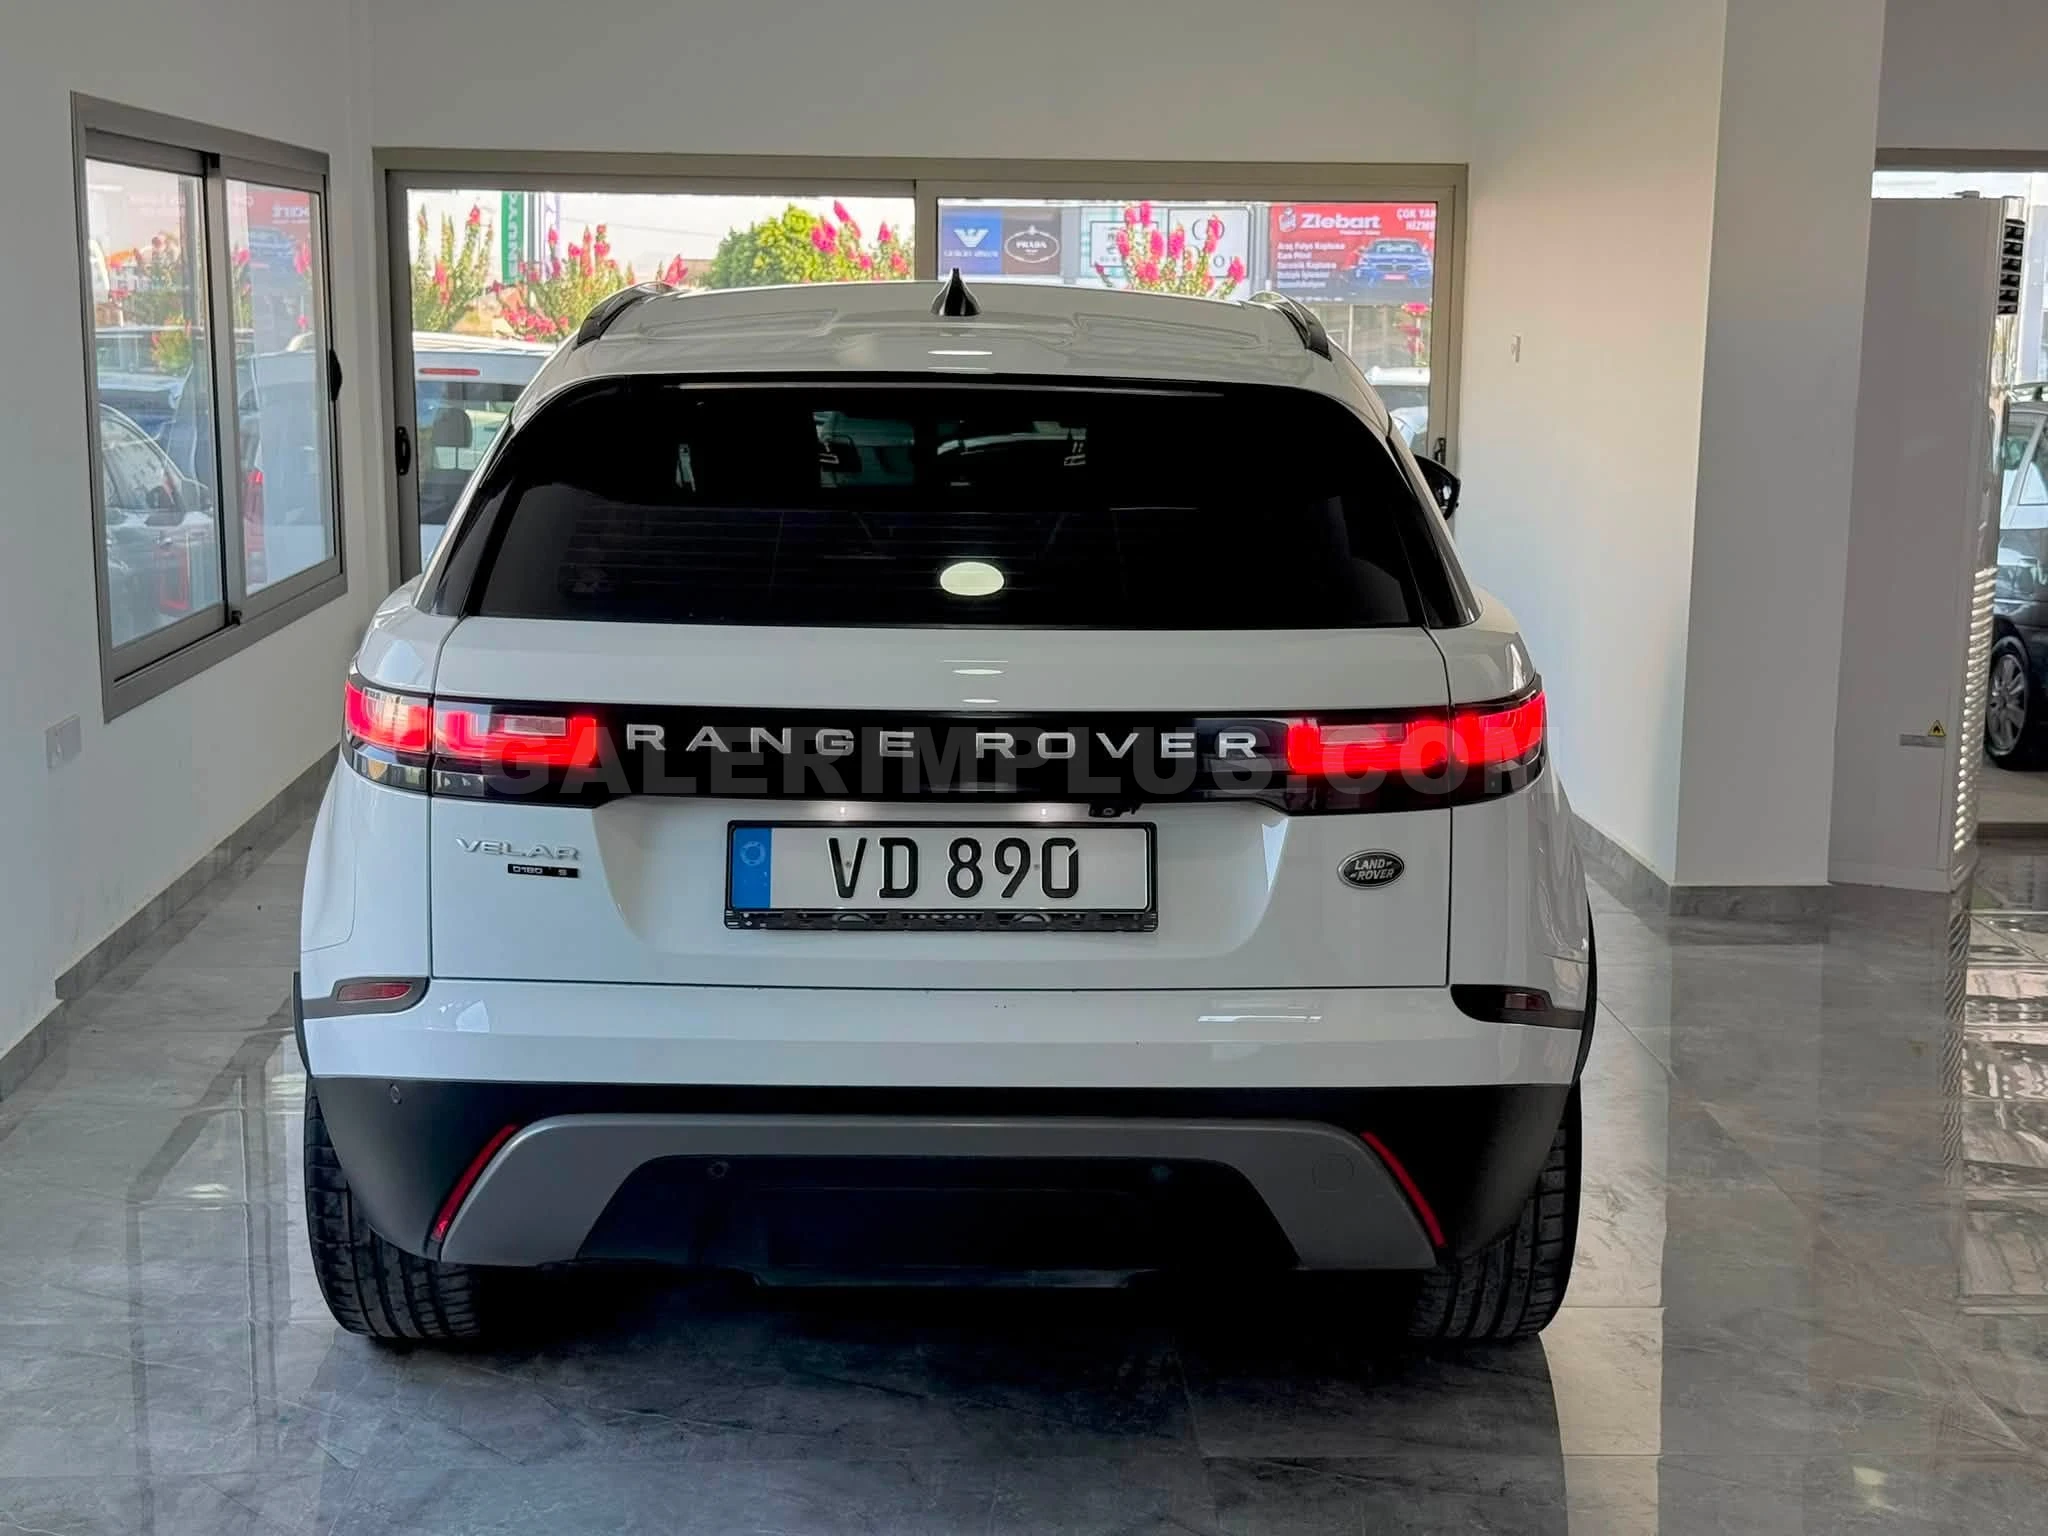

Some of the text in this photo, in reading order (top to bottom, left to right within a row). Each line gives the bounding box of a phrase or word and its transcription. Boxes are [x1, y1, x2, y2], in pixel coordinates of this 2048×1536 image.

[1016, 240, 1047, 249] PRADA
[626, 723, 1257, 759] RANGE ROVER
[456, 838, 579, 860] VELAR
[512, 865, 543, 874] D180
[826, 837, 1079, 899] VD 890
[1354, 859, 1386, 870] LAND
[1356, 868, 1395, 880] ROVER
